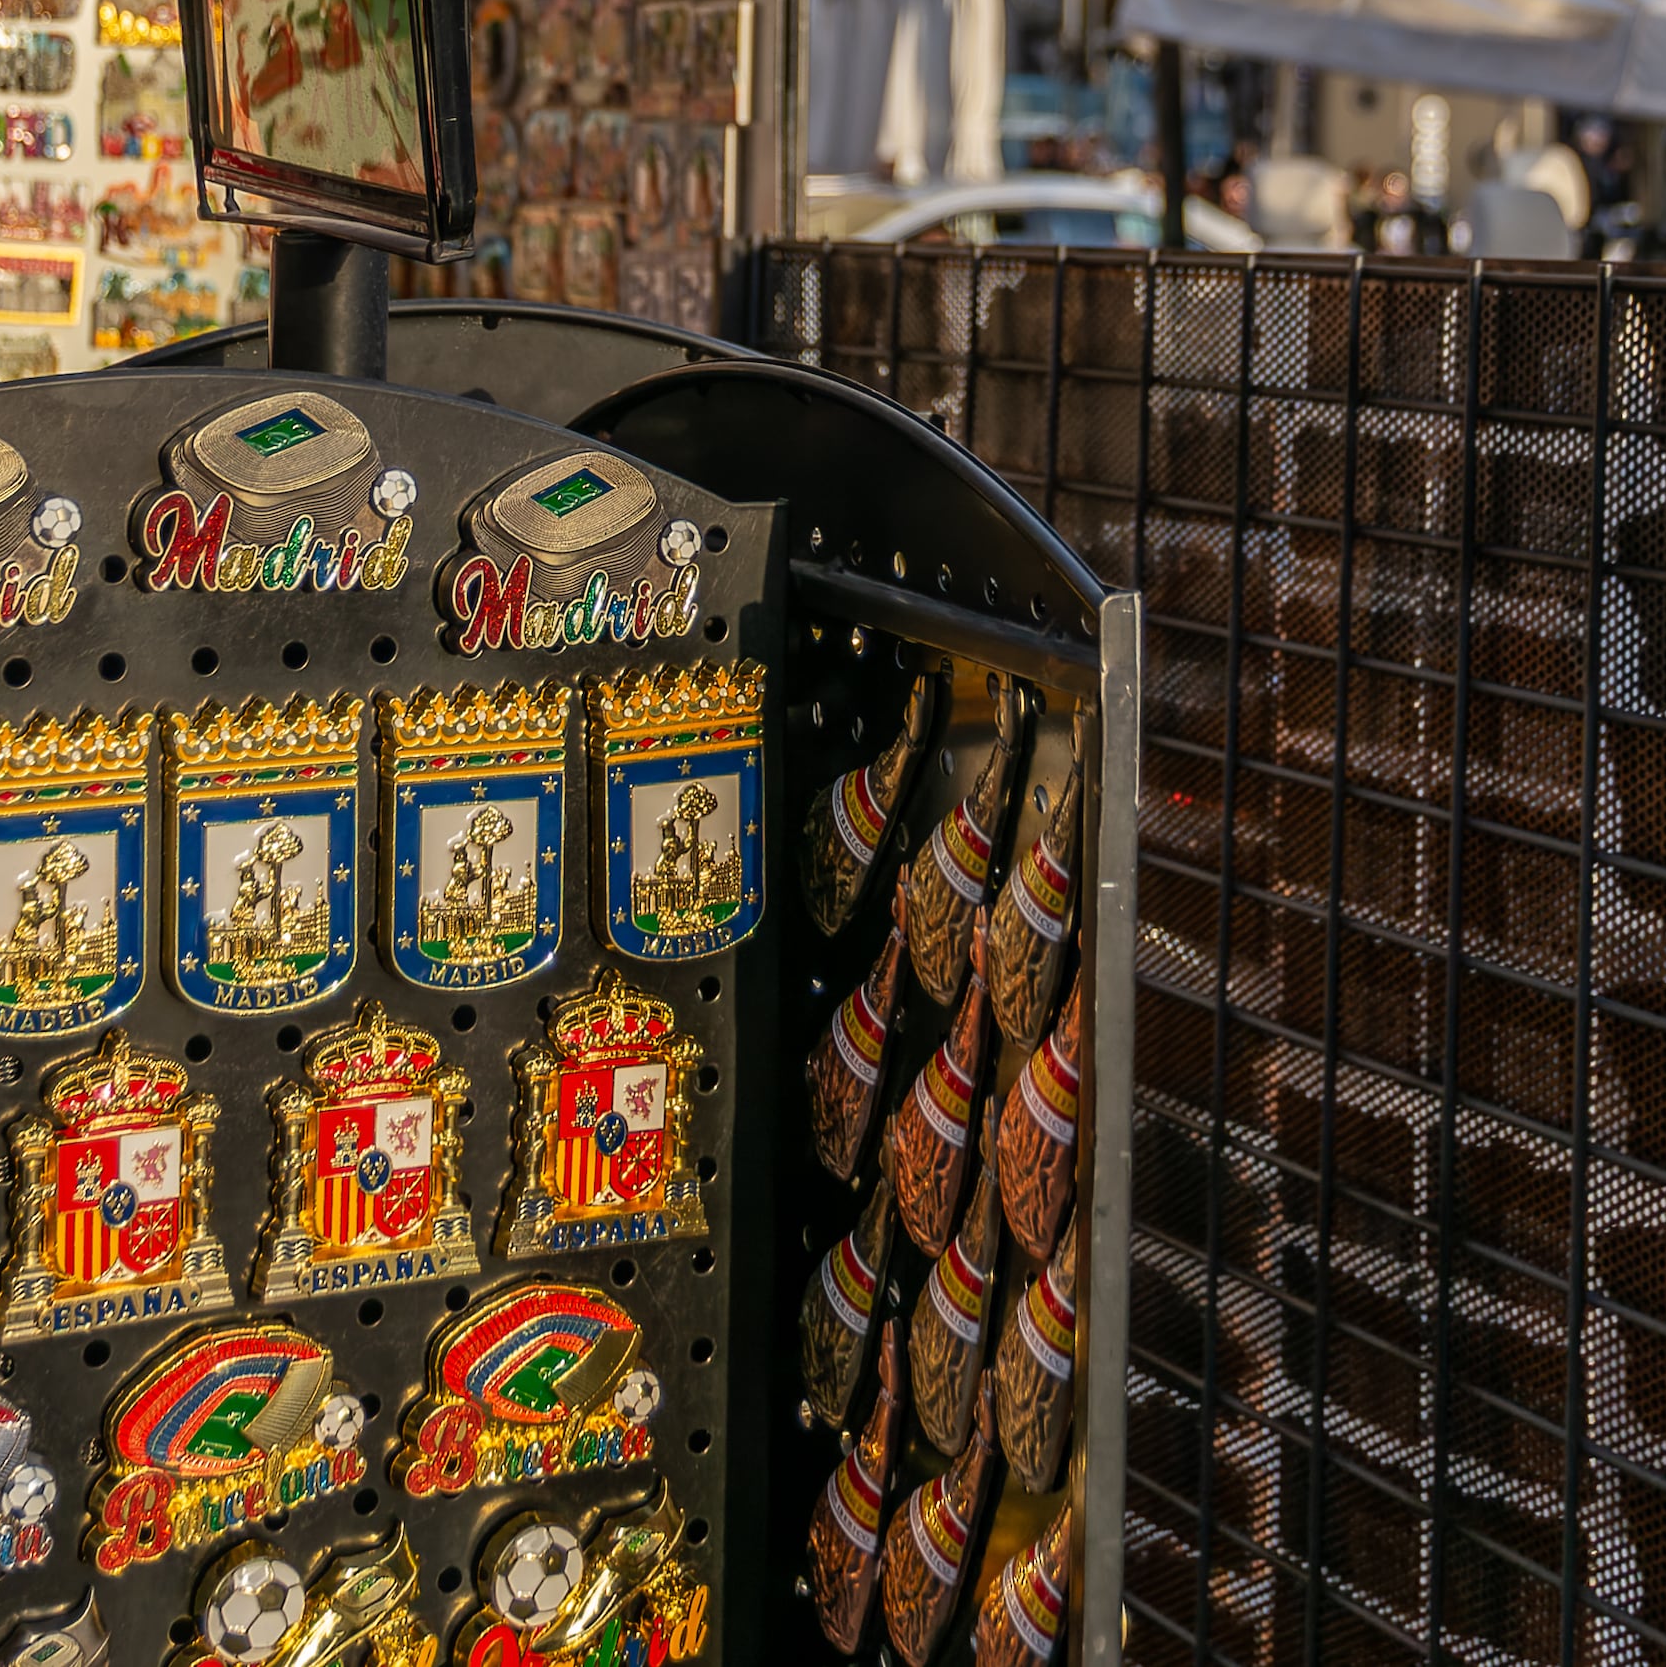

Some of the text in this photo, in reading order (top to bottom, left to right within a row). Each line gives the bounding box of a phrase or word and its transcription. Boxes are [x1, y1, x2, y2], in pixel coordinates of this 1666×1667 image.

[143, 491, 413, 592] Madrid
[454, 553, 701, 655] Madrid
[642, 927, 733, 957] MADRID
[215, 977, 319, 1010] MADRID
[428, 957, 526, 986] MADRID
[551, 1214, 667, 1252] ESPAÑA
[311, 1250, 435, 1293] ESPAÑA
[52, 1287, 188, 1332] ESPAÑA
[404, 1403, 655, 1498] Barcelona
[95, 1443, 367, 1576] Barcelona
